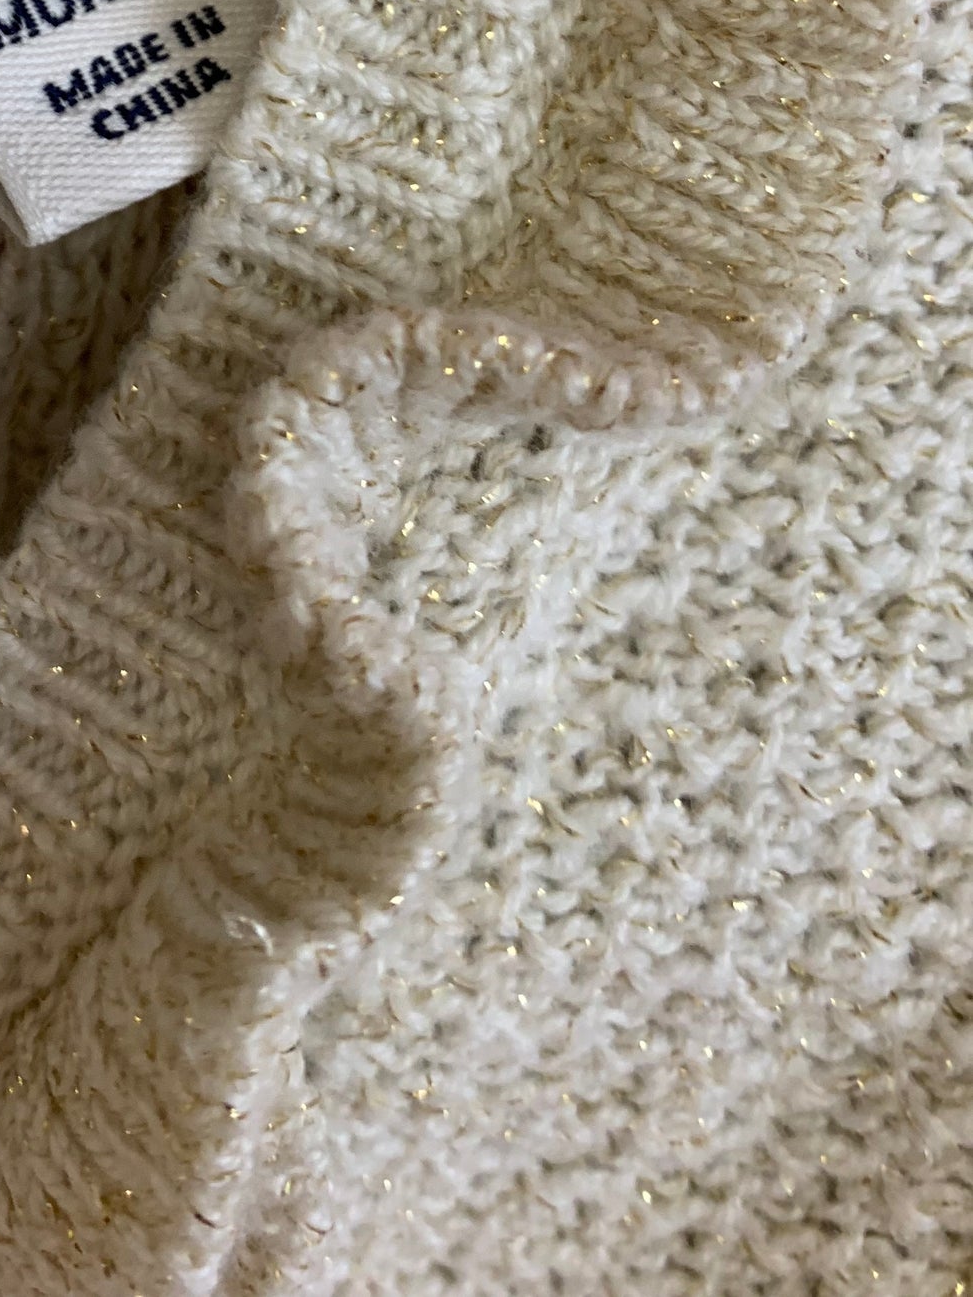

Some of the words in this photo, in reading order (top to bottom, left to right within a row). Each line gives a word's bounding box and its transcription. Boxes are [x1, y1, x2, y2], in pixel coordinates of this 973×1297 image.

[42, 33, 169, 114] MADE
[172, 5, 226, 48] IN
[90, 57, 232, 141] CHINA
